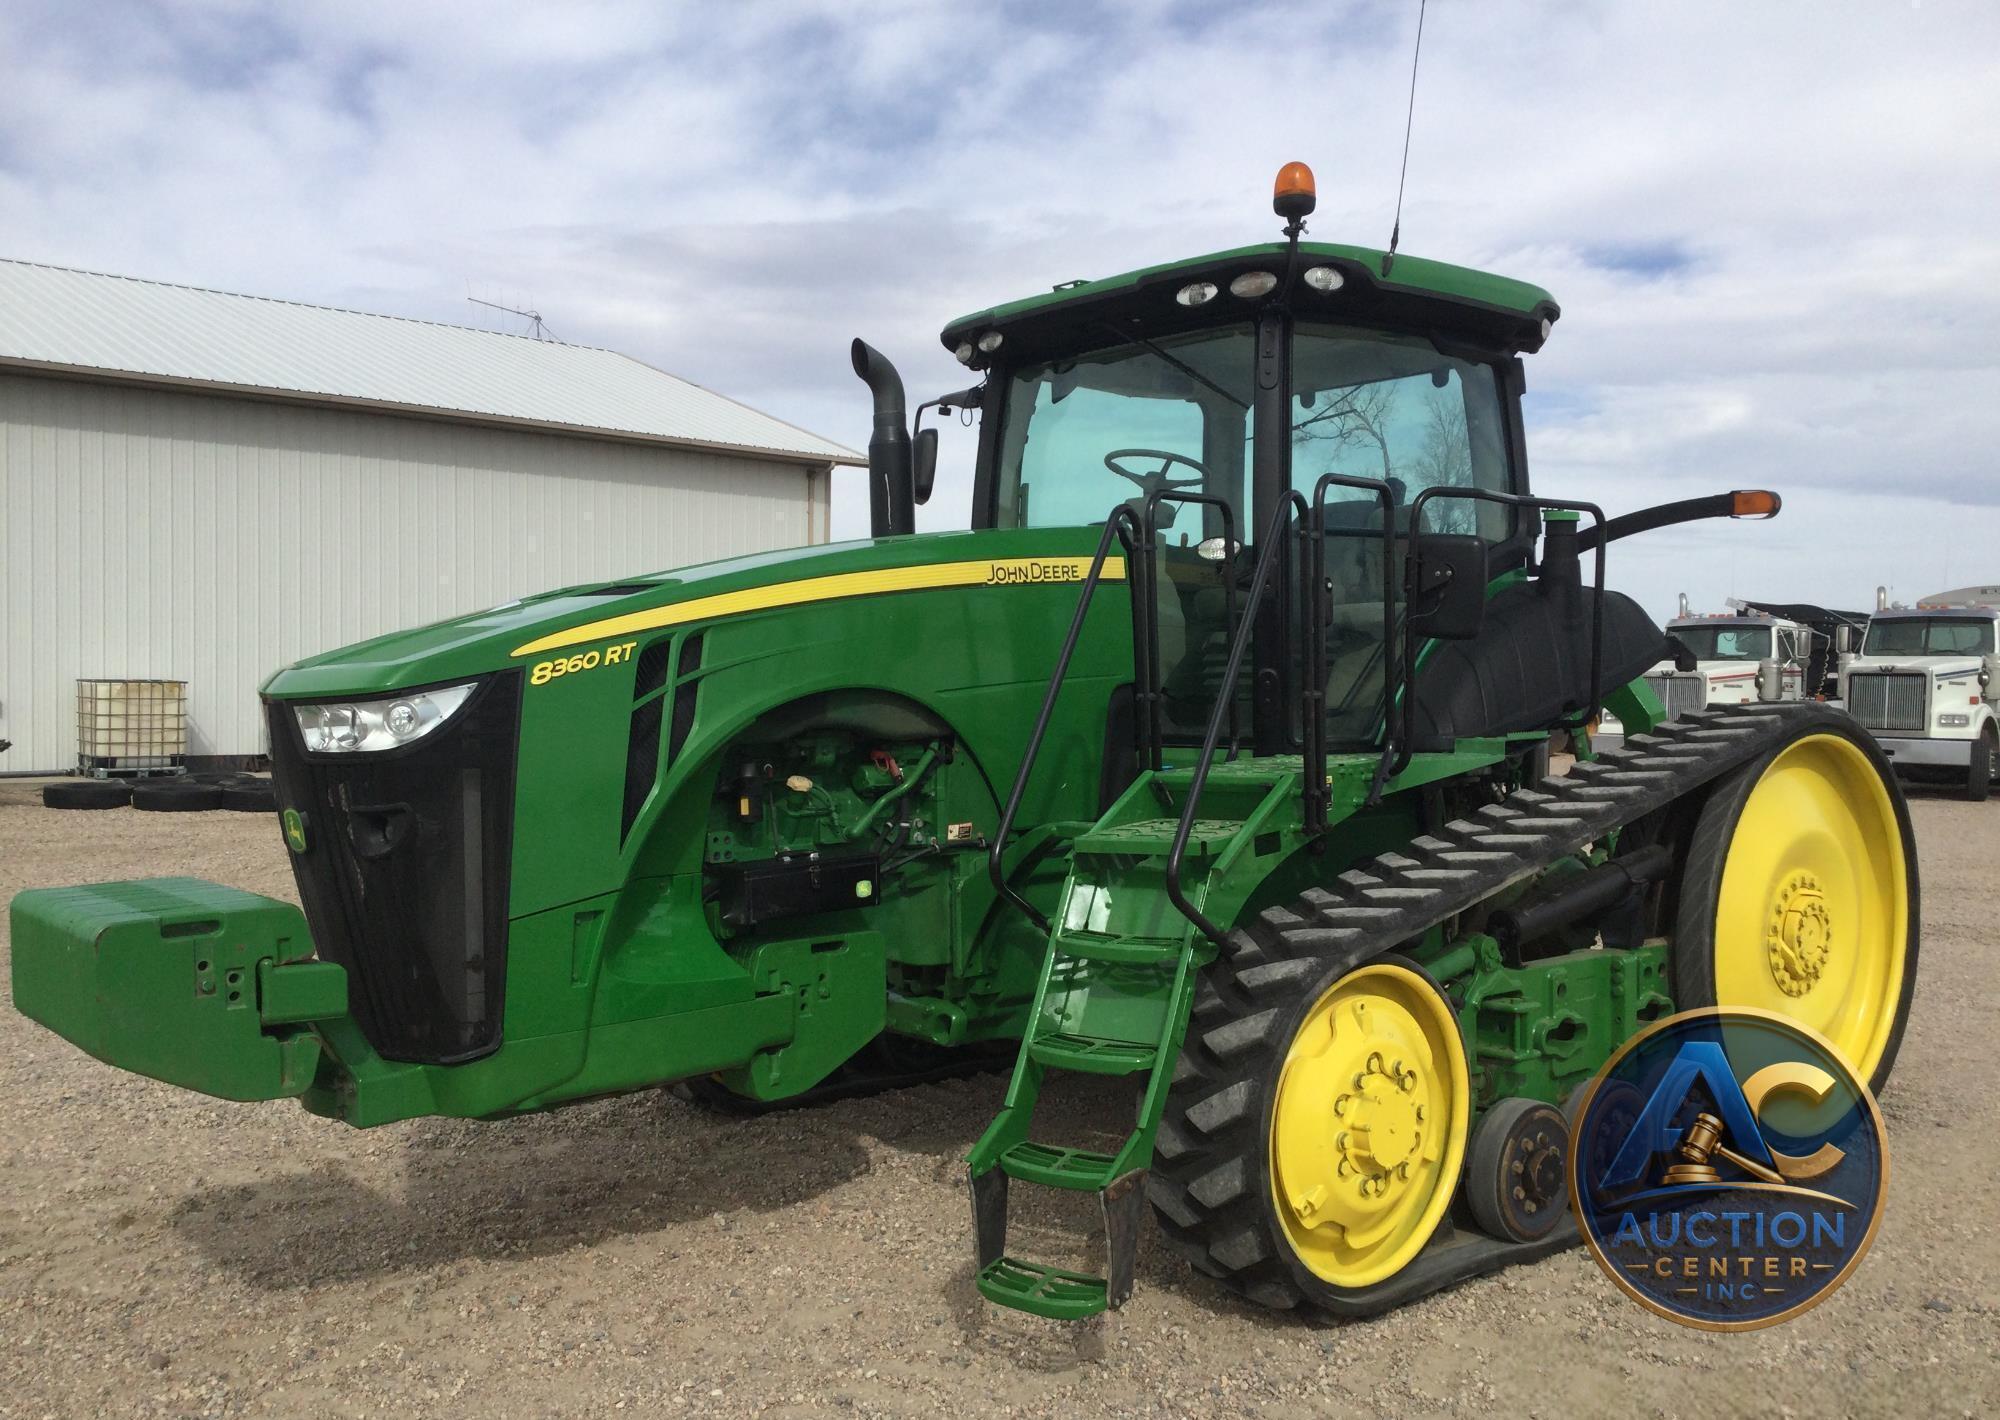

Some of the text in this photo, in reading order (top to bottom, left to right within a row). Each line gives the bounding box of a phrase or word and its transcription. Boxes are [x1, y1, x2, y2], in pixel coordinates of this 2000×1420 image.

[987, 562, 1080, 582] JOHN DEERE
[530, 641, 637, 685] 8360 RT
